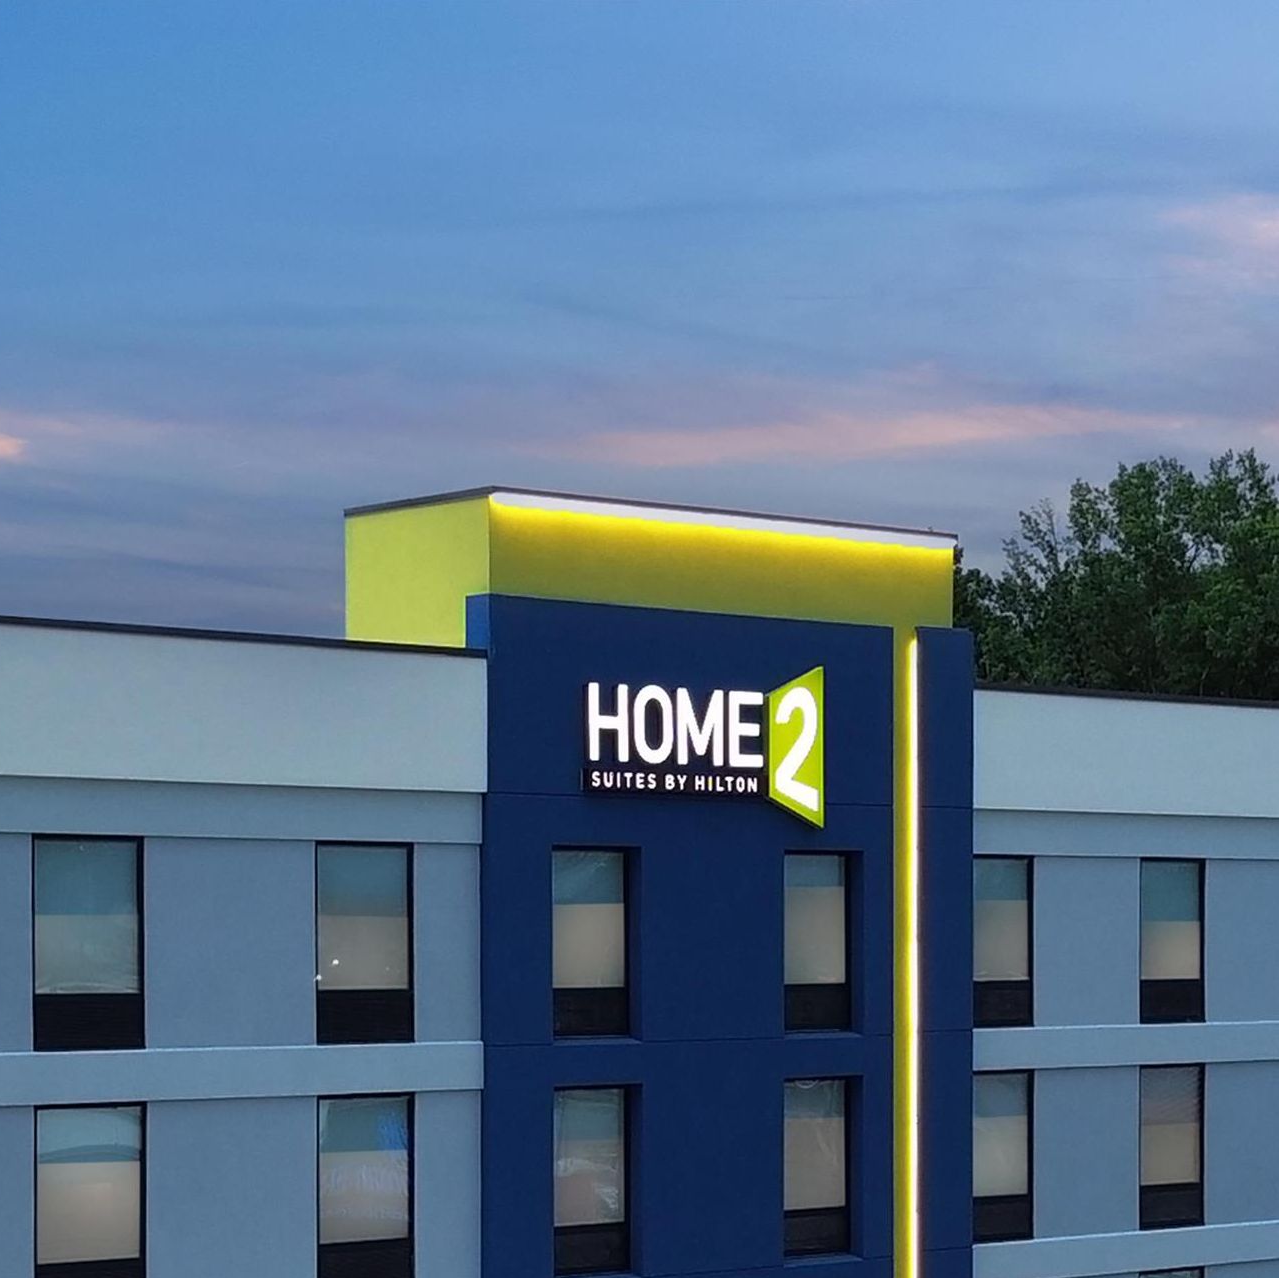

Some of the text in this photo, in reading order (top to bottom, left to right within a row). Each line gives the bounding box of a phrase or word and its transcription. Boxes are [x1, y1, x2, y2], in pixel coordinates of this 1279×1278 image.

[591, 770, 758, 794] SUITES BY HILTON
